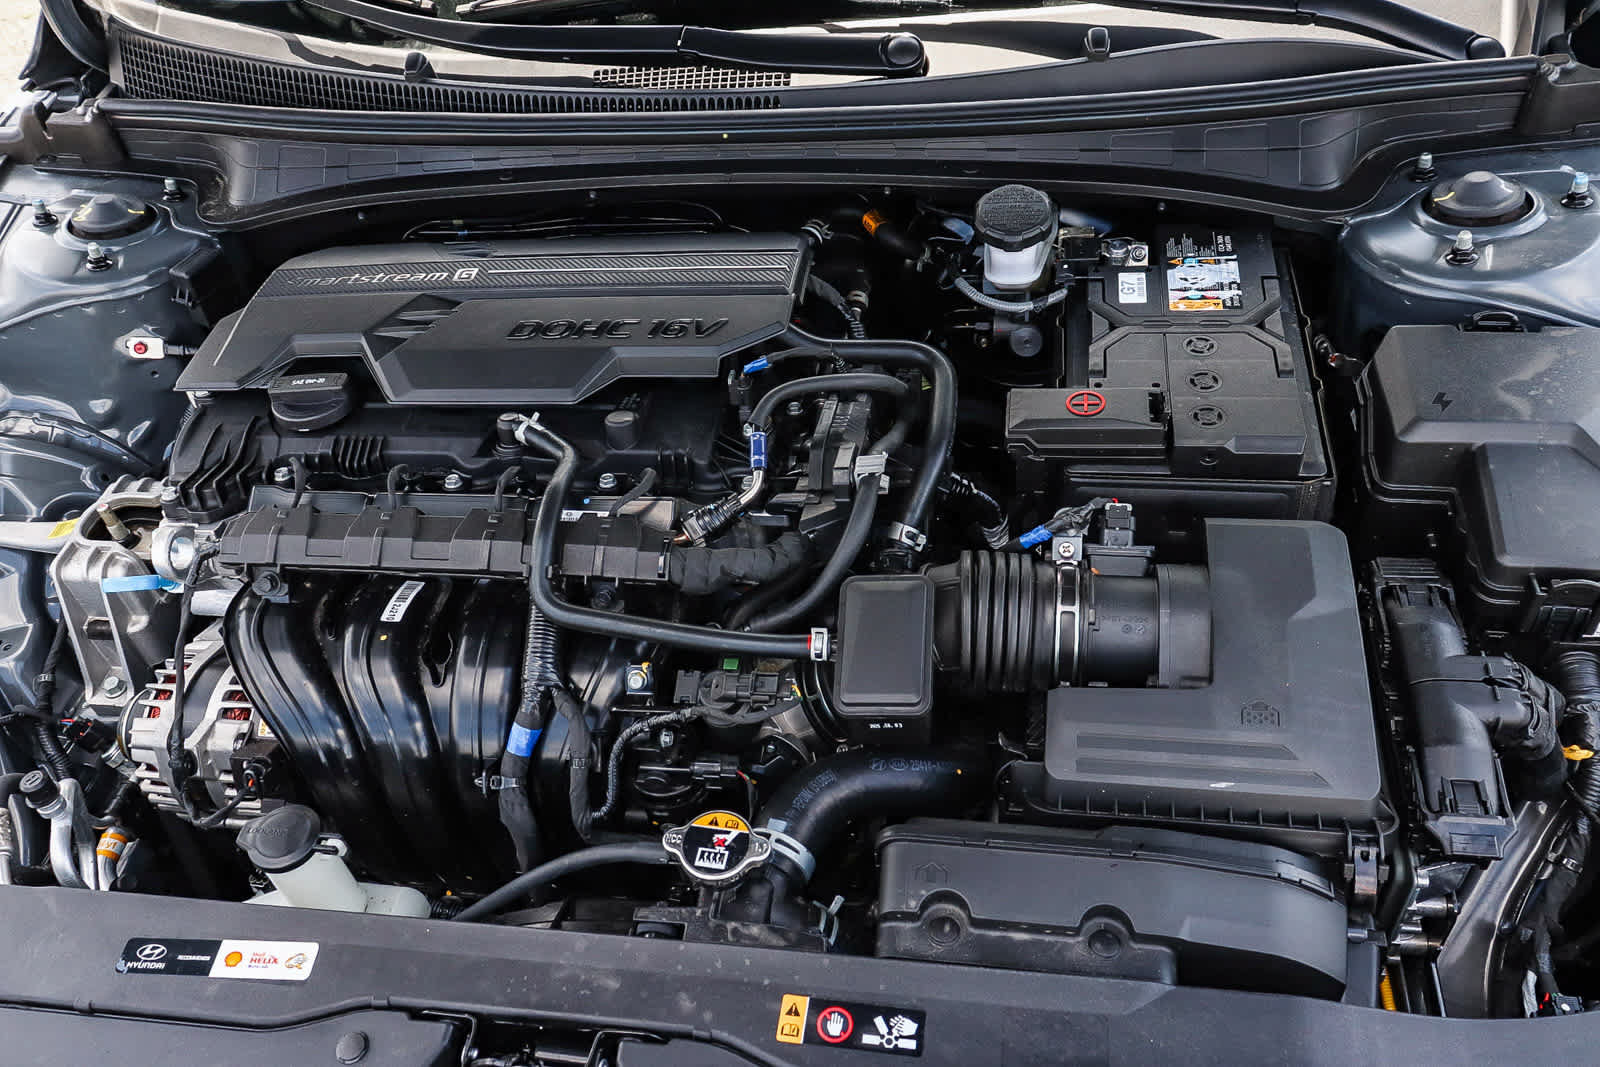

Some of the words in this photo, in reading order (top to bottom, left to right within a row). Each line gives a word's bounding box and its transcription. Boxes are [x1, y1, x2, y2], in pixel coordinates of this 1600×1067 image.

[1120, 280, 1135, 295] G7
[505, 319, 641, 340] DOHC
[647, 317, 729, 338] 16V
[126, 960, 166, 970] HYUNDAI
[249, 957, 279, 965] HELIX
